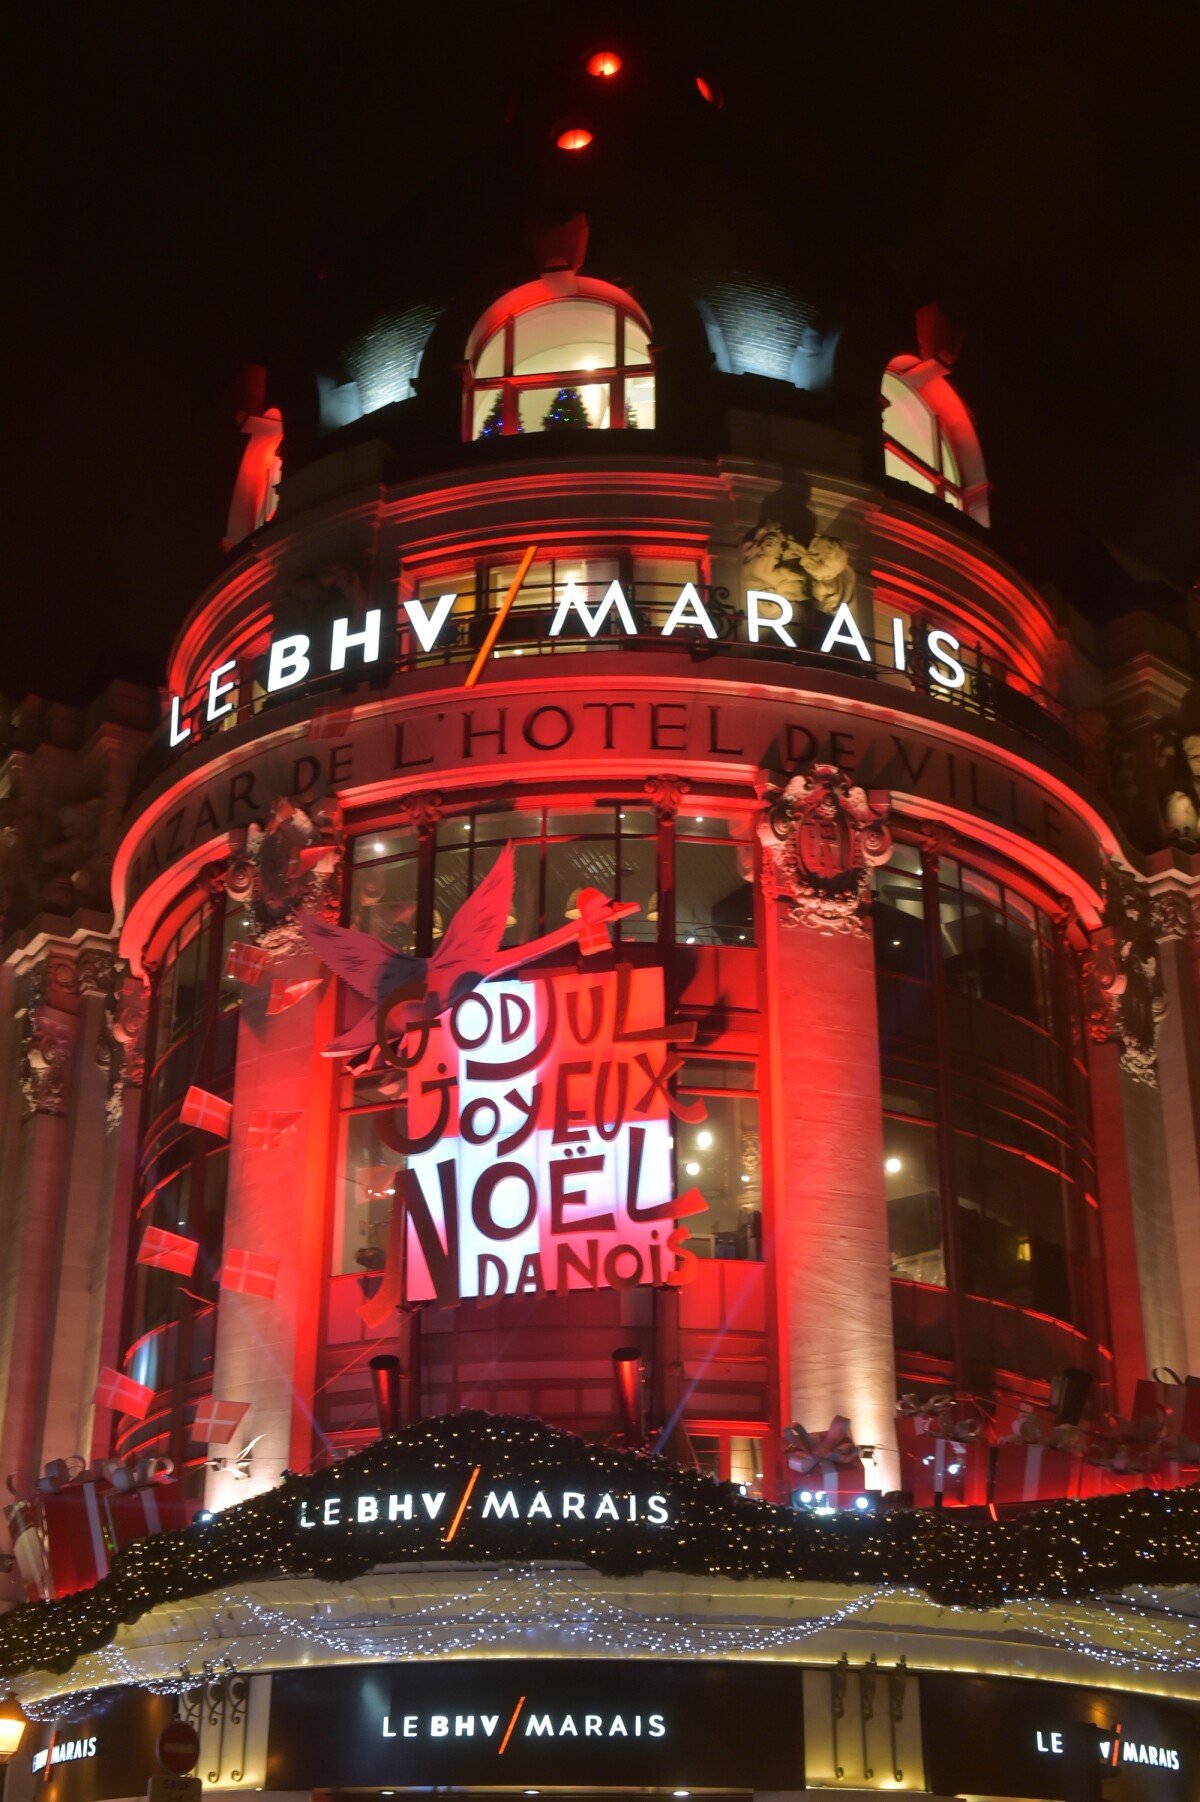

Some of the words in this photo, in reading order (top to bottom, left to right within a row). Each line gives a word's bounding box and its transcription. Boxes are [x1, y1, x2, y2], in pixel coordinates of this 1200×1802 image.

[169, 660, 236, 748] LE
[266, 593, 458, 693] BHV
[548, 579, 967, 689] MARAIS
[292, 743, 353, 795] DE
[393, 702, 744, 771] L'HOTEL
[784, 722, 856, 773] DE
[891, 735, 1064, 854] VILLE
[375, 977, 531, 1070] GOD
[356, 1127, 710, 1330] NOËL
[299, 1498, 342, 1528] LE
[356, 1491, 447, 1524] BHV
[481, 1490, 670, 1525] MARAIS
[50, 1736, 97, 1764] MARAIS
[382, 1715, 419, 1737] LE
[430, 1714, 500, 1738] BHV
[524, 1714, 667, 1738] MARAIS
[1036, 1730, 1064, 1754] LE
[1123, 1741, 1179, 1770] MARAIS
